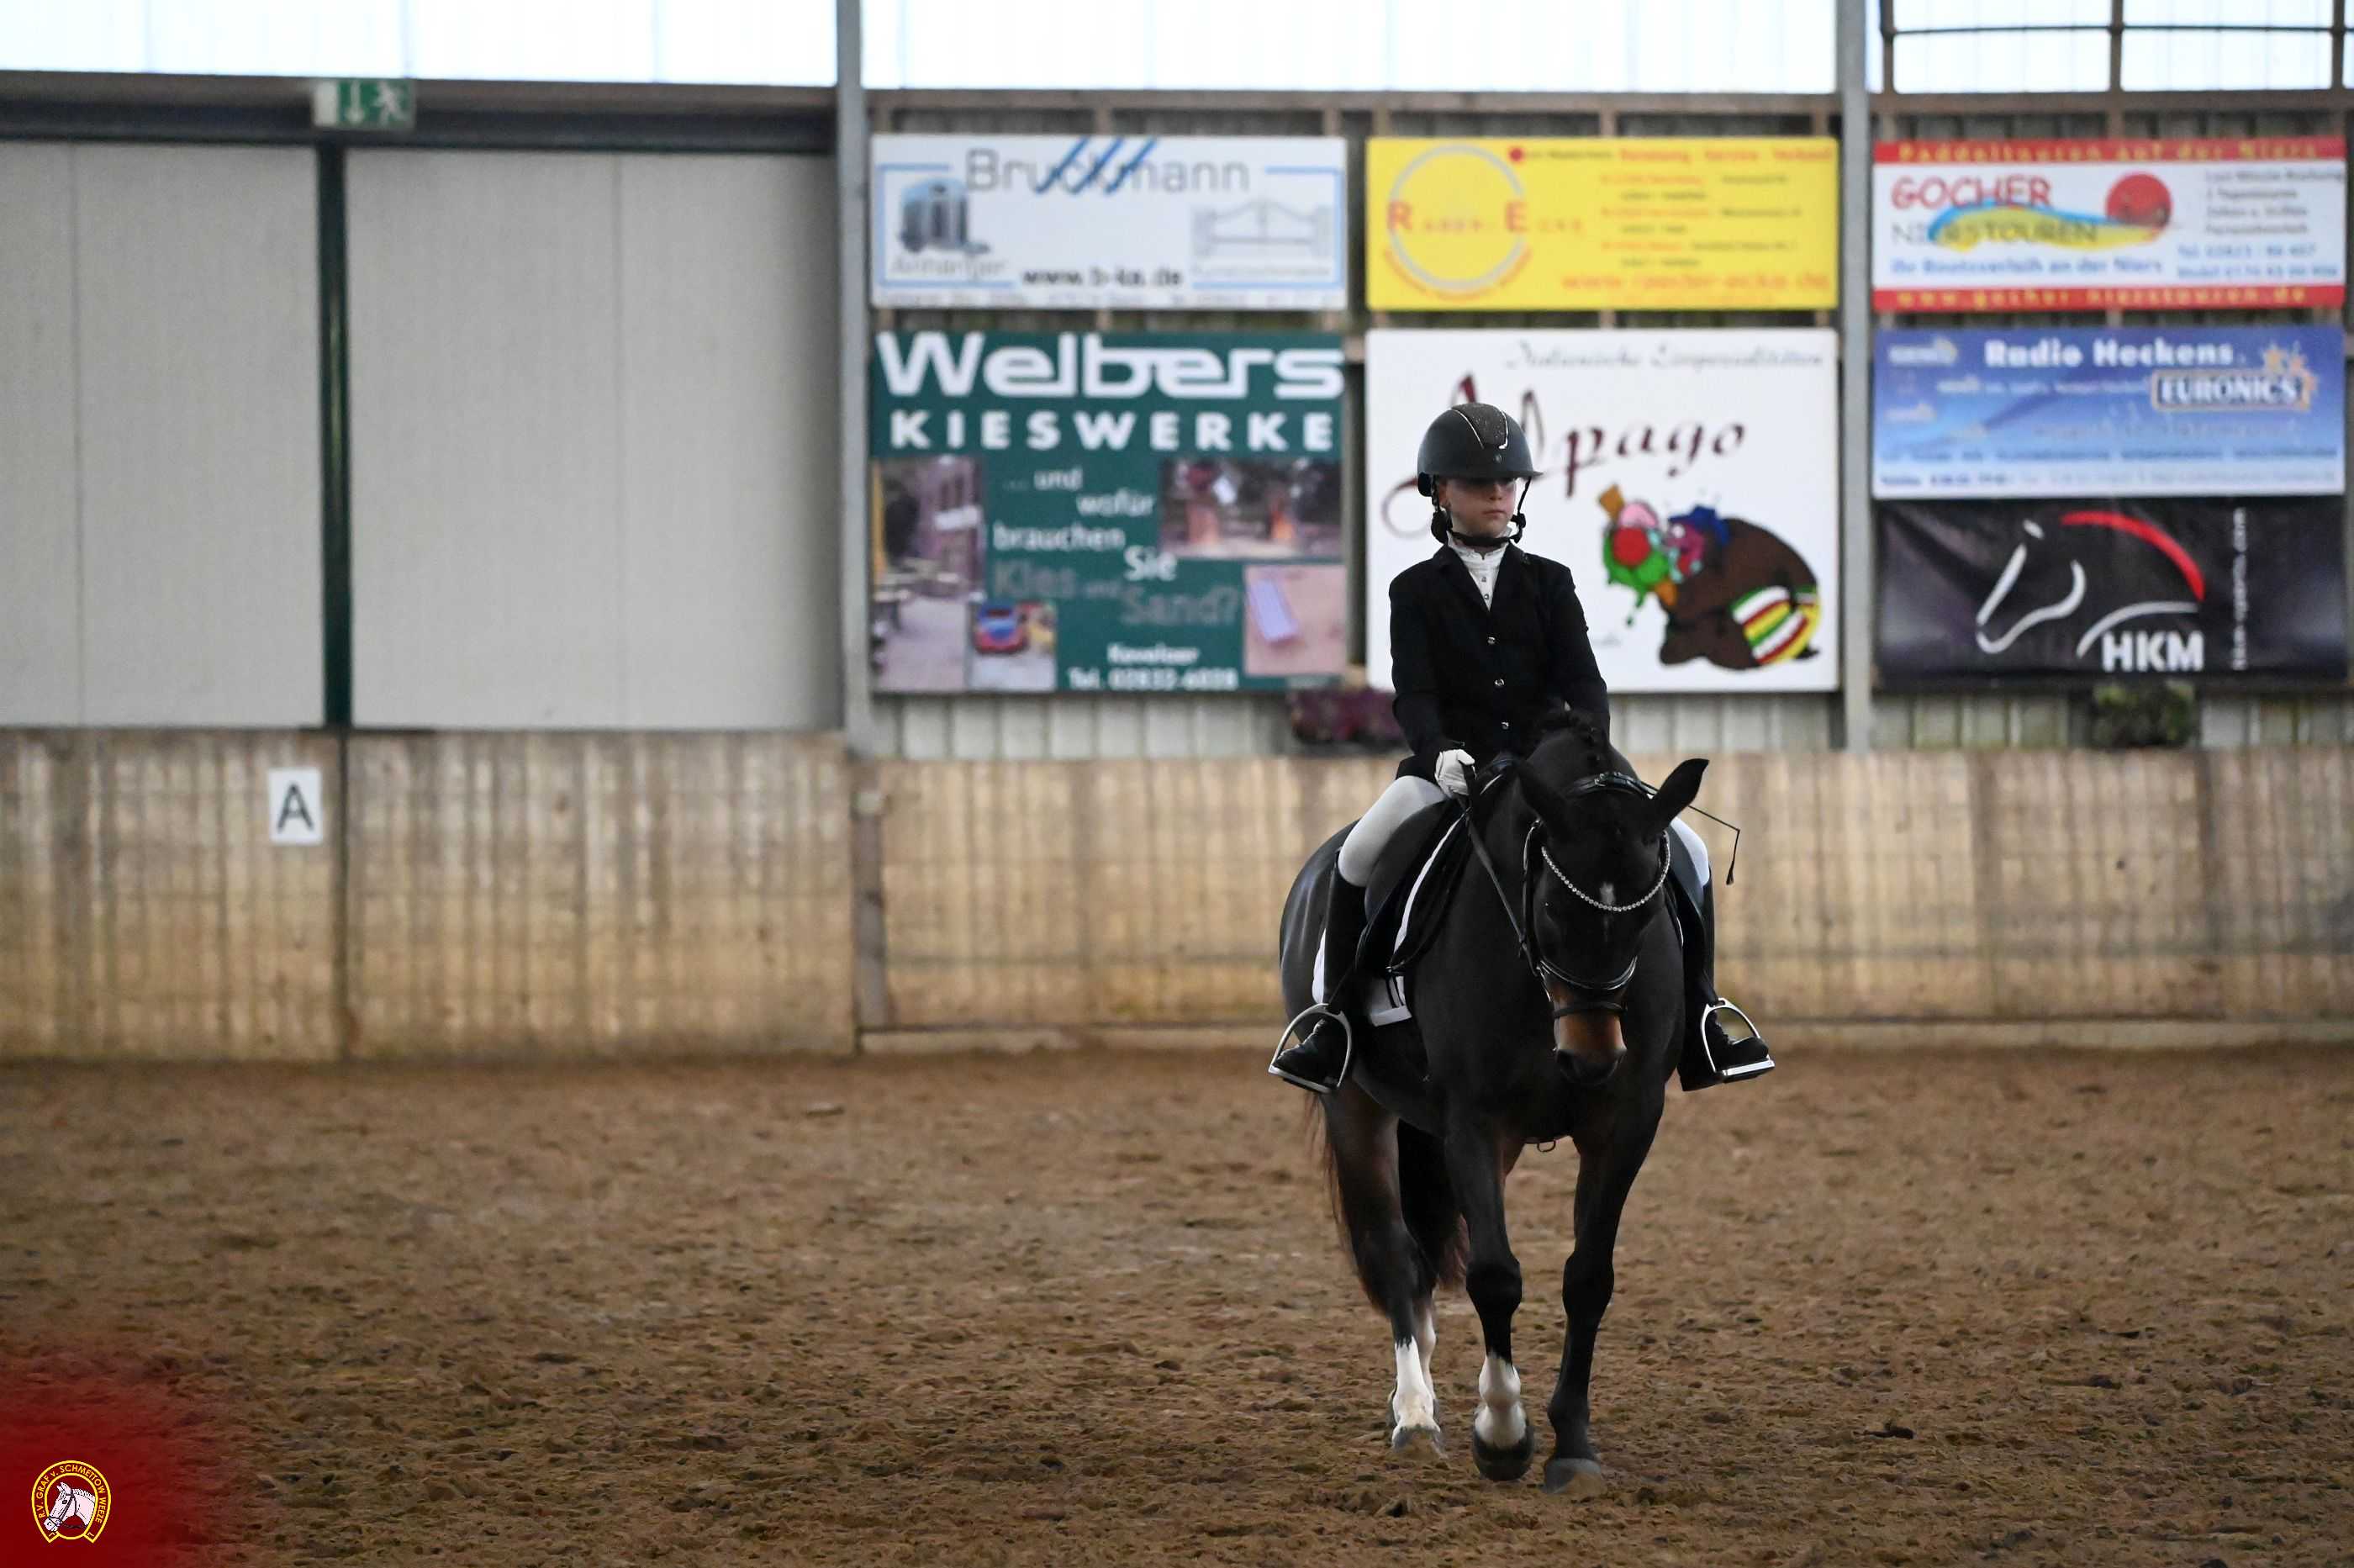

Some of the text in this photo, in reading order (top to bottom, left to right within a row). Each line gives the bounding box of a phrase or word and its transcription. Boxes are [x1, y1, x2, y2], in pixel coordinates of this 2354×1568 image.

[1892, 173, 2052, 210] GOCHER
[877, 330, 1344, 398] Welbers
[1984, 338, 2083, 367] Radio
[2158, 377, 2299, 404] EURONICS
[890, 412, 1333, 451] KIESWERKE
[1034, 468, 1083, 491] und
[993, 521, 1127, 552] brauchen
[1123, 545, 1176, 582] Sie
[2103, 631, 2204, 673] HKM
[277, 784, 314, 832] A
